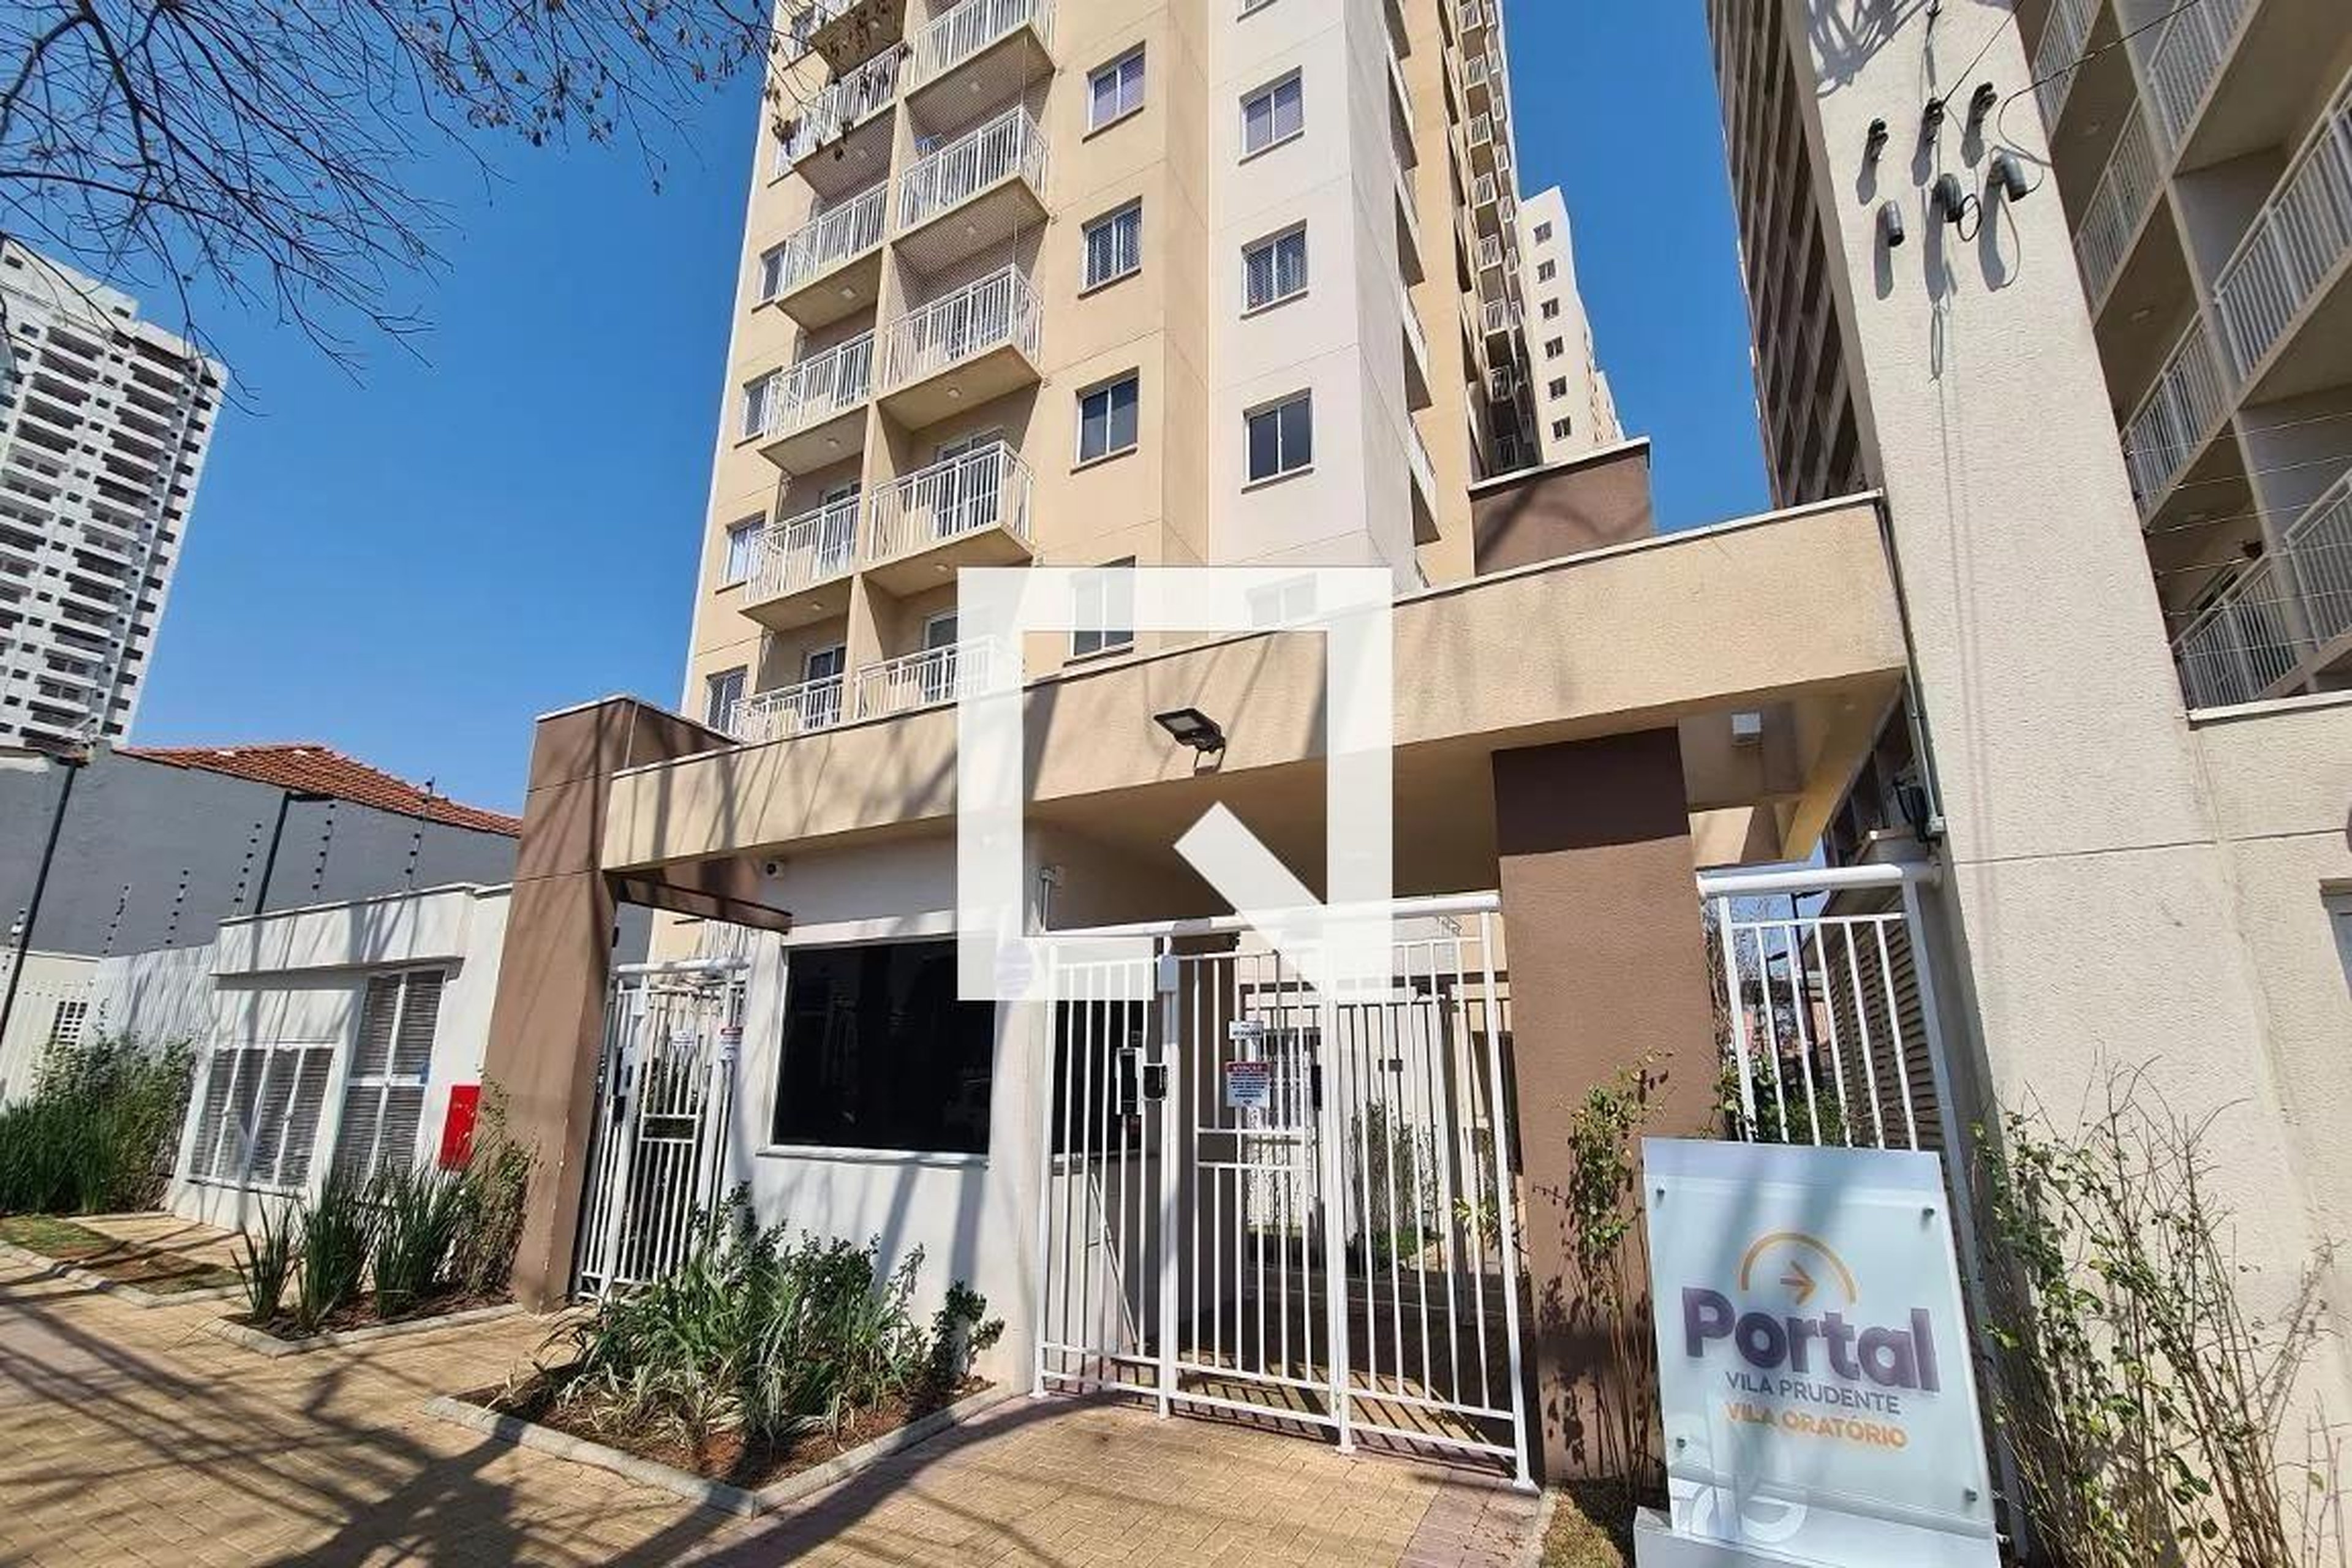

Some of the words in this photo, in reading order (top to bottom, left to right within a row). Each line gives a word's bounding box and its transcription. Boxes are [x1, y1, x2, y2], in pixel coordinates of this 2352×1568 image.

[1682, 1287, 1940, 1392] Portal
[1726, 1371, 1774, 1395] VILA
[1779, 1379, 1901, 1415] PRUDENTE
[1726, 1402, 1776, 1427] VILA
[1782, 1411, 1908, 1449] ORATÓRIO
